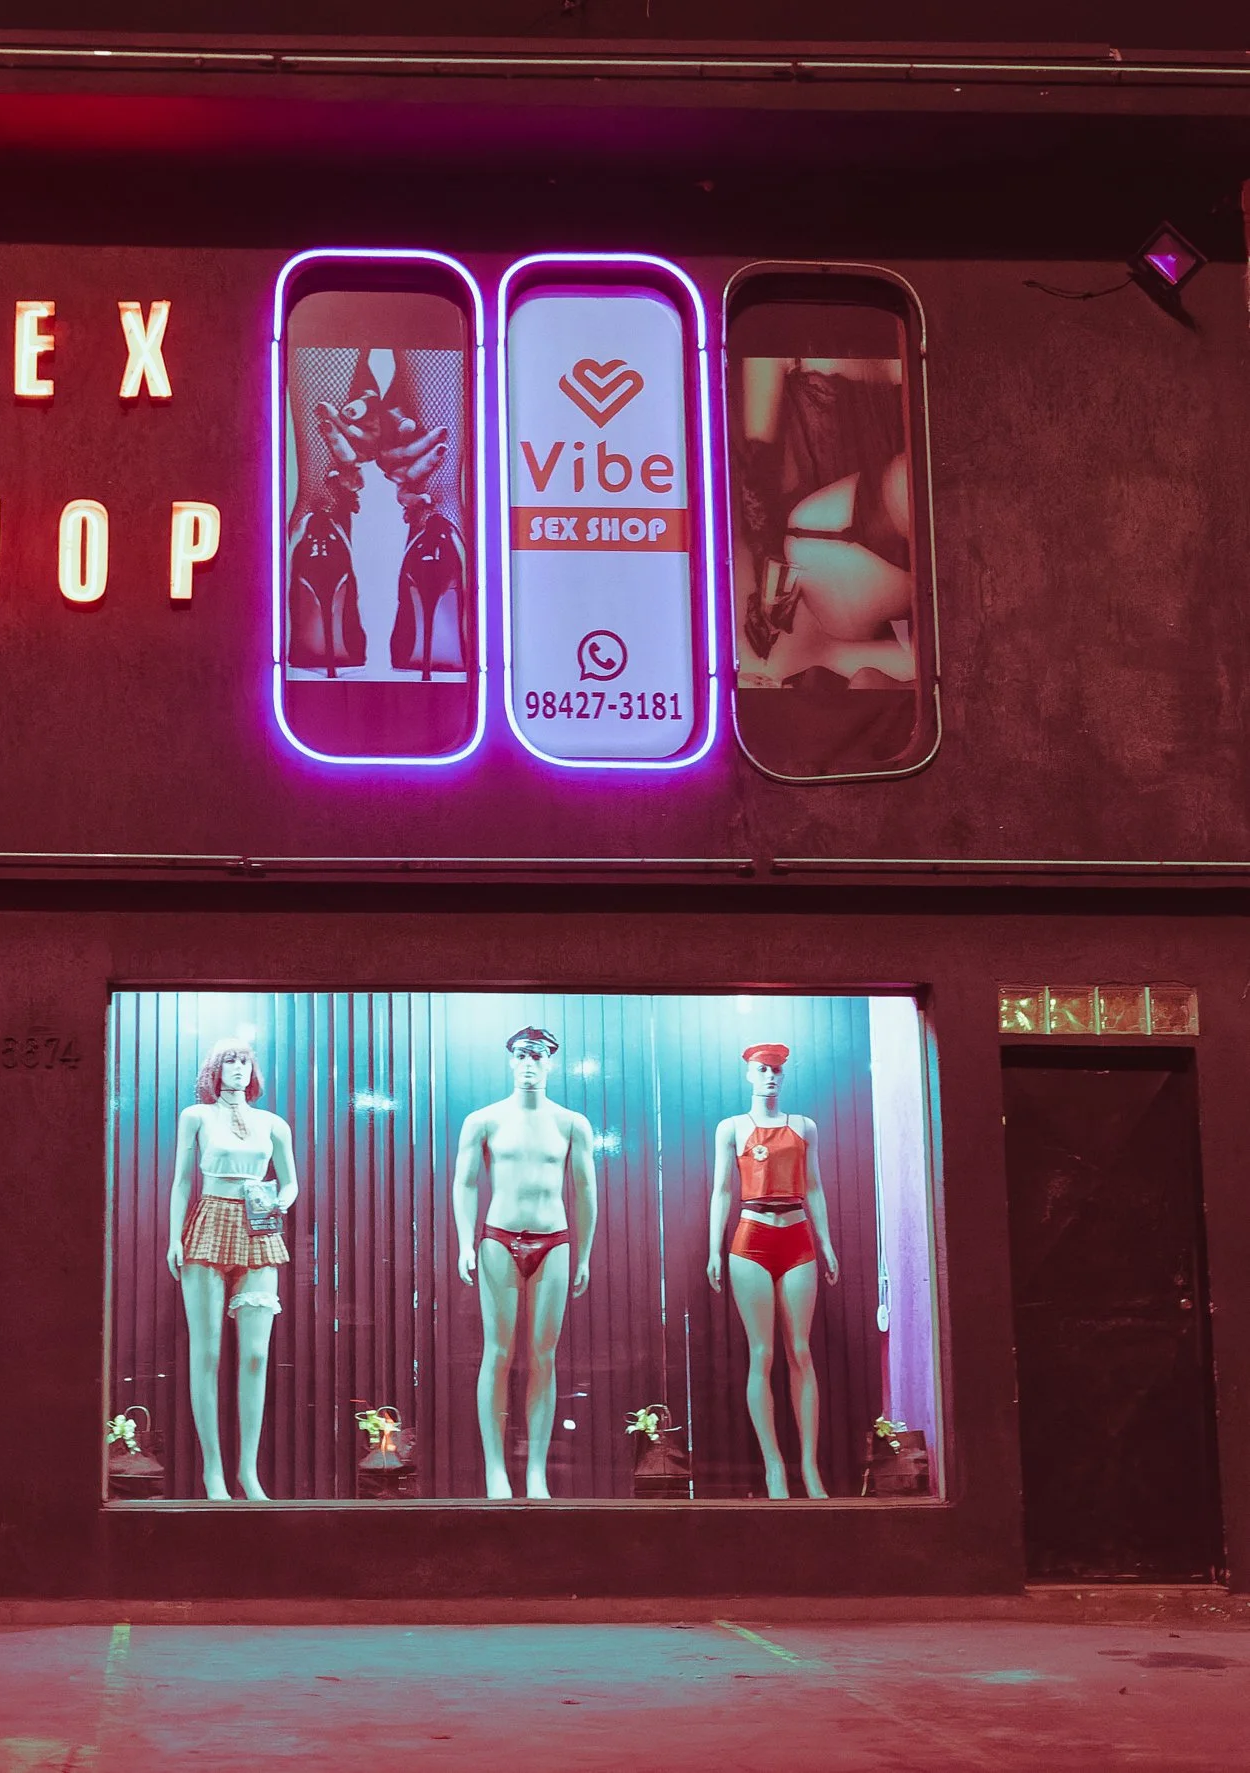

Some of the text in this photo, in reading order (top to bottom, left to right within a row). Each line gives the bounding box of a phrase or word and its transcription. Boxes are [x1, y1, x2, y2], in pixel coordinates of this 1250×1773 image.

[520, 440, 675, 494] Vibe
[529, 517, 667, 542] SEX SHOP
[524, 690, 683, 721] 98427-3181
